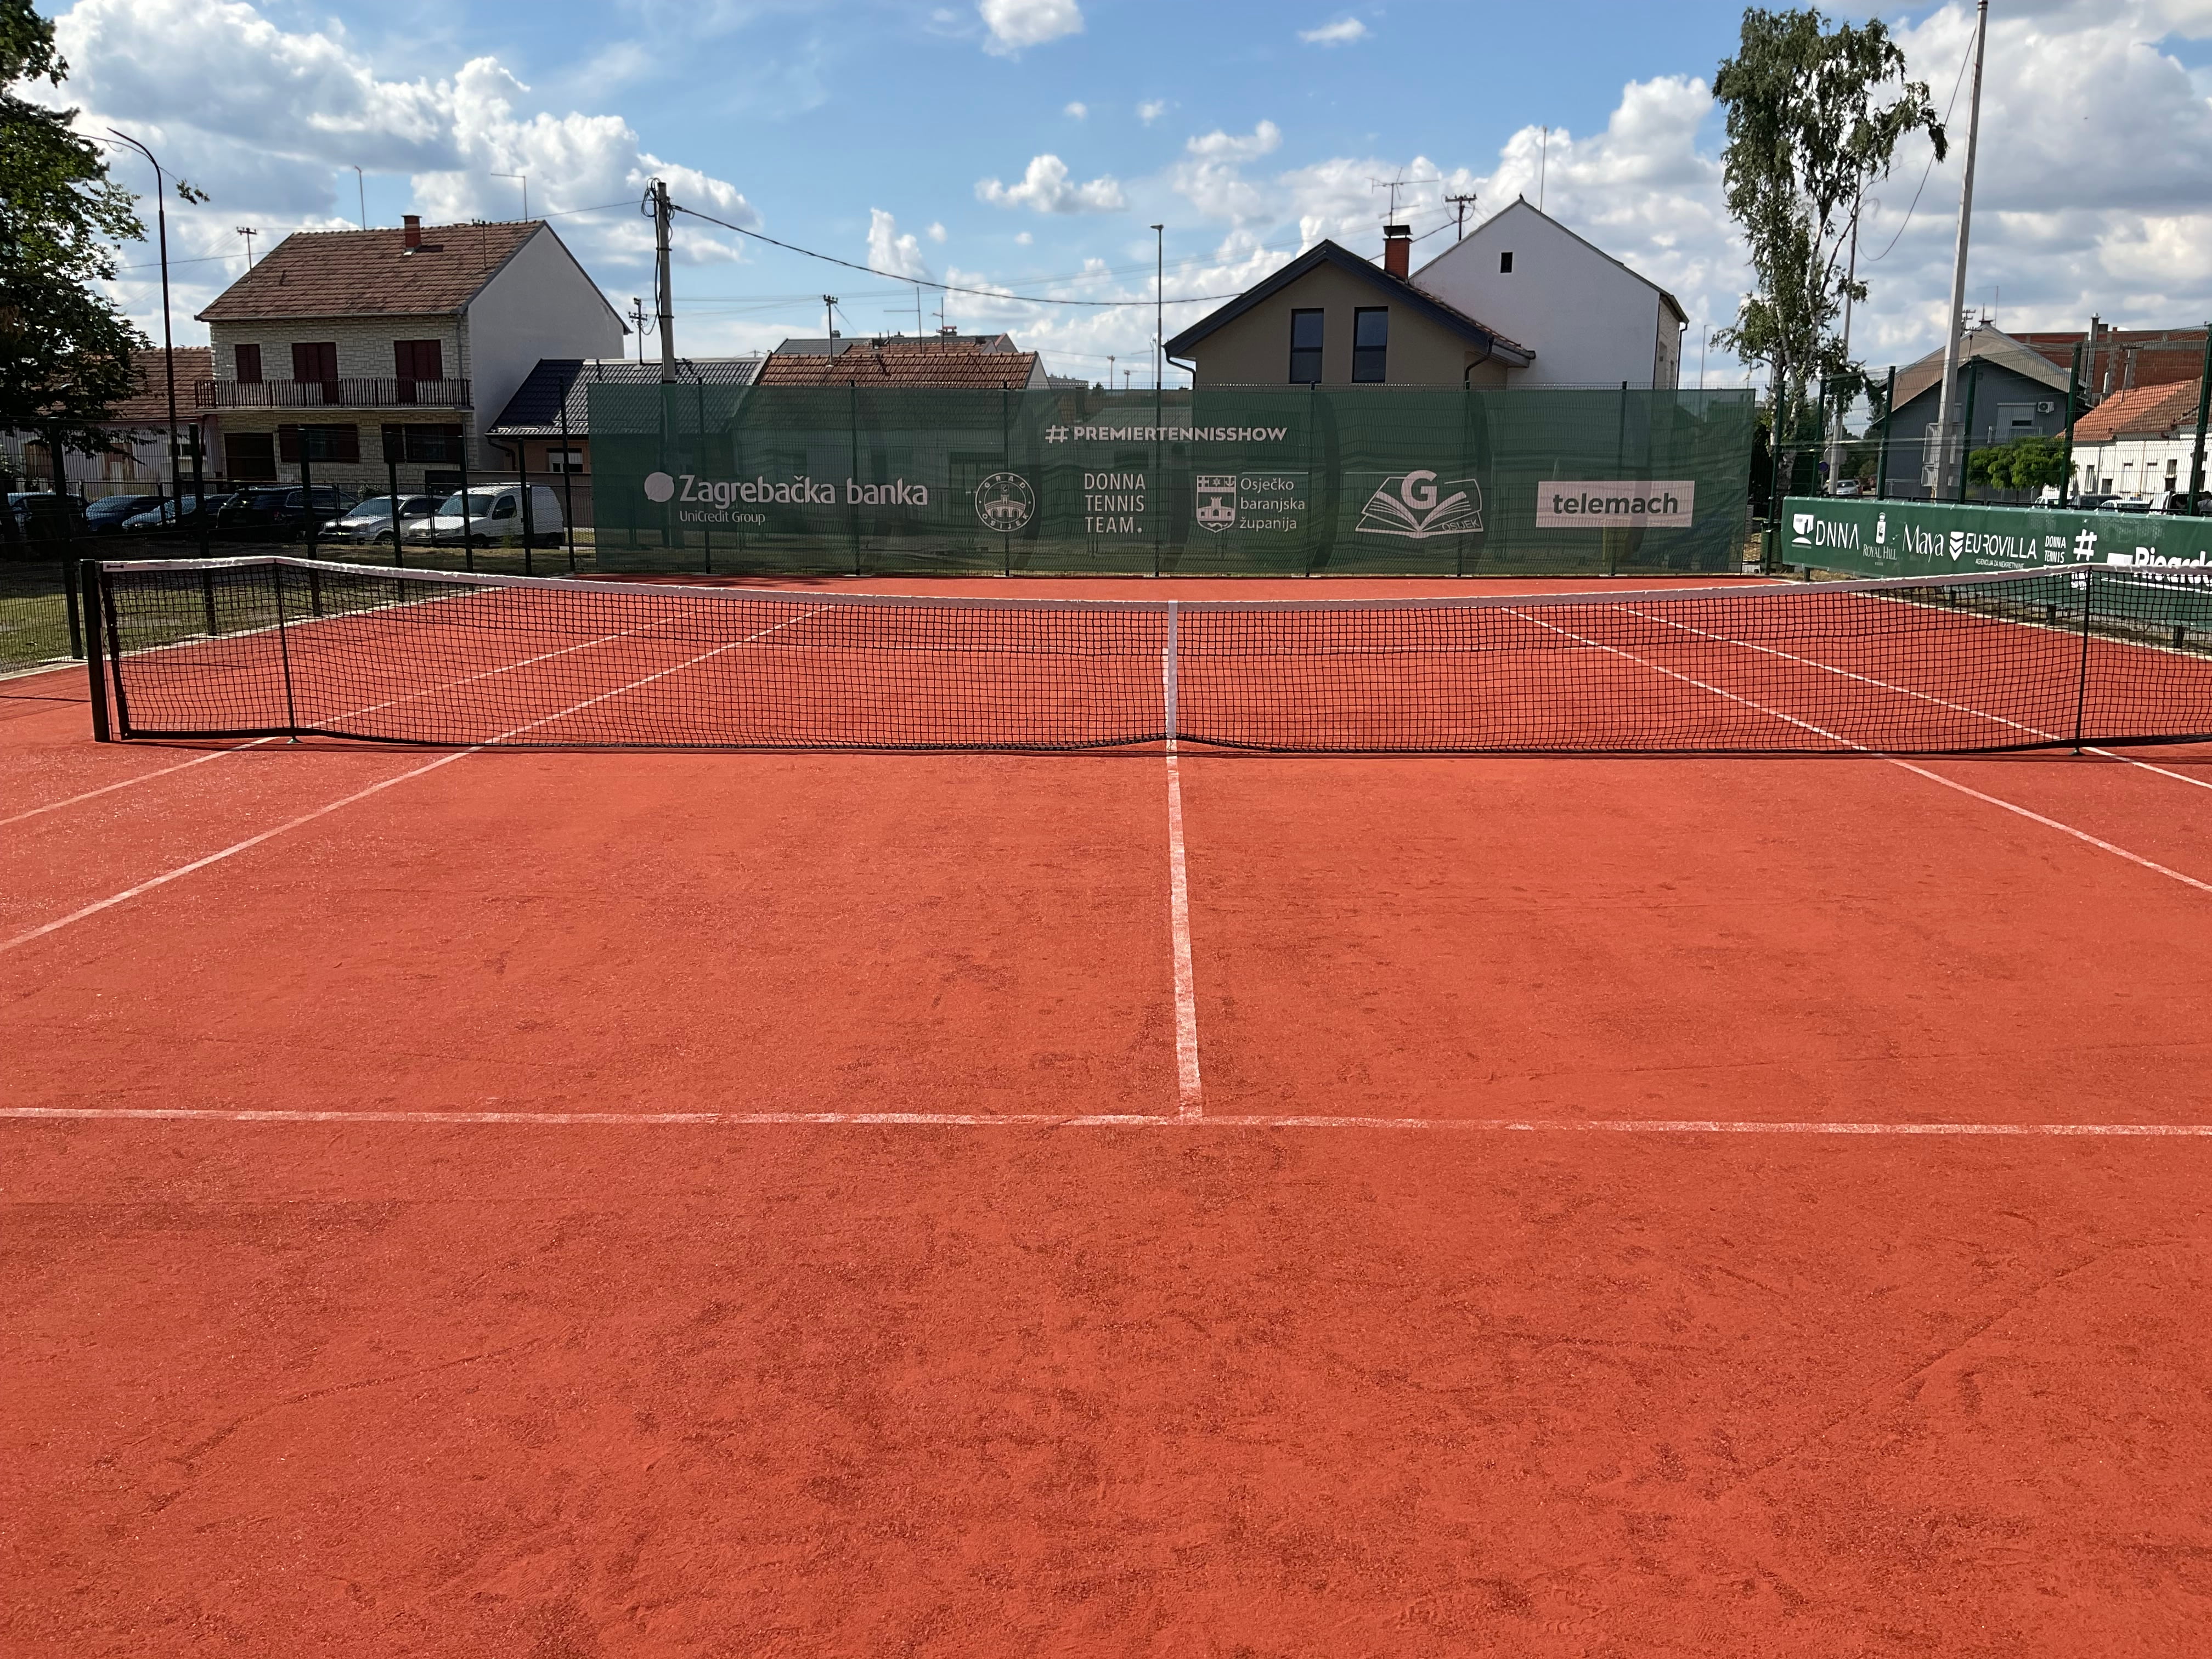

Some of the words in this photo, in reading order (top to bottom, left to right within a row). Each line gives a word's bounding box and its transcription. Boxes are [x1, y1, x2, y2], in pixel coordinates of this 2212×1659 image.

[1045, 425, 1288, 443] #PREMIERTENNISSHOW
[1084, 473, 1146, 490] DONNA
[1240, 478, 1295, 493] Osječko
[1401, 470, 1437, 510] G
[679, 475, 836, 510] Zagrebačka
[847, 477, 928, 505] banka
[1085, 494, 1145, 512] TENNIS
[1240, 497, 1306, 513] baranjska
[1553, 492, 1678, 514] telemach
[680, 510, 729, 522] UniCredit
[732, 511, 766, 526] Group
[1085, 516, 1143, 533] TEAM.
[1239, 517, 1297, 532] županija
[1441, 519, 1481, 531] OSIJEK
[1901, 523, 1944, 563] Maya
[1965, 532, 2037, 560] EUROVILLA
[2045, 535, 2067, 549] DONNA
[1863, 544, 1882, 558] ROYAL
[1883, 546, 1898, 560] HILL
[2044, 550, 2065, 563] TENNIS
